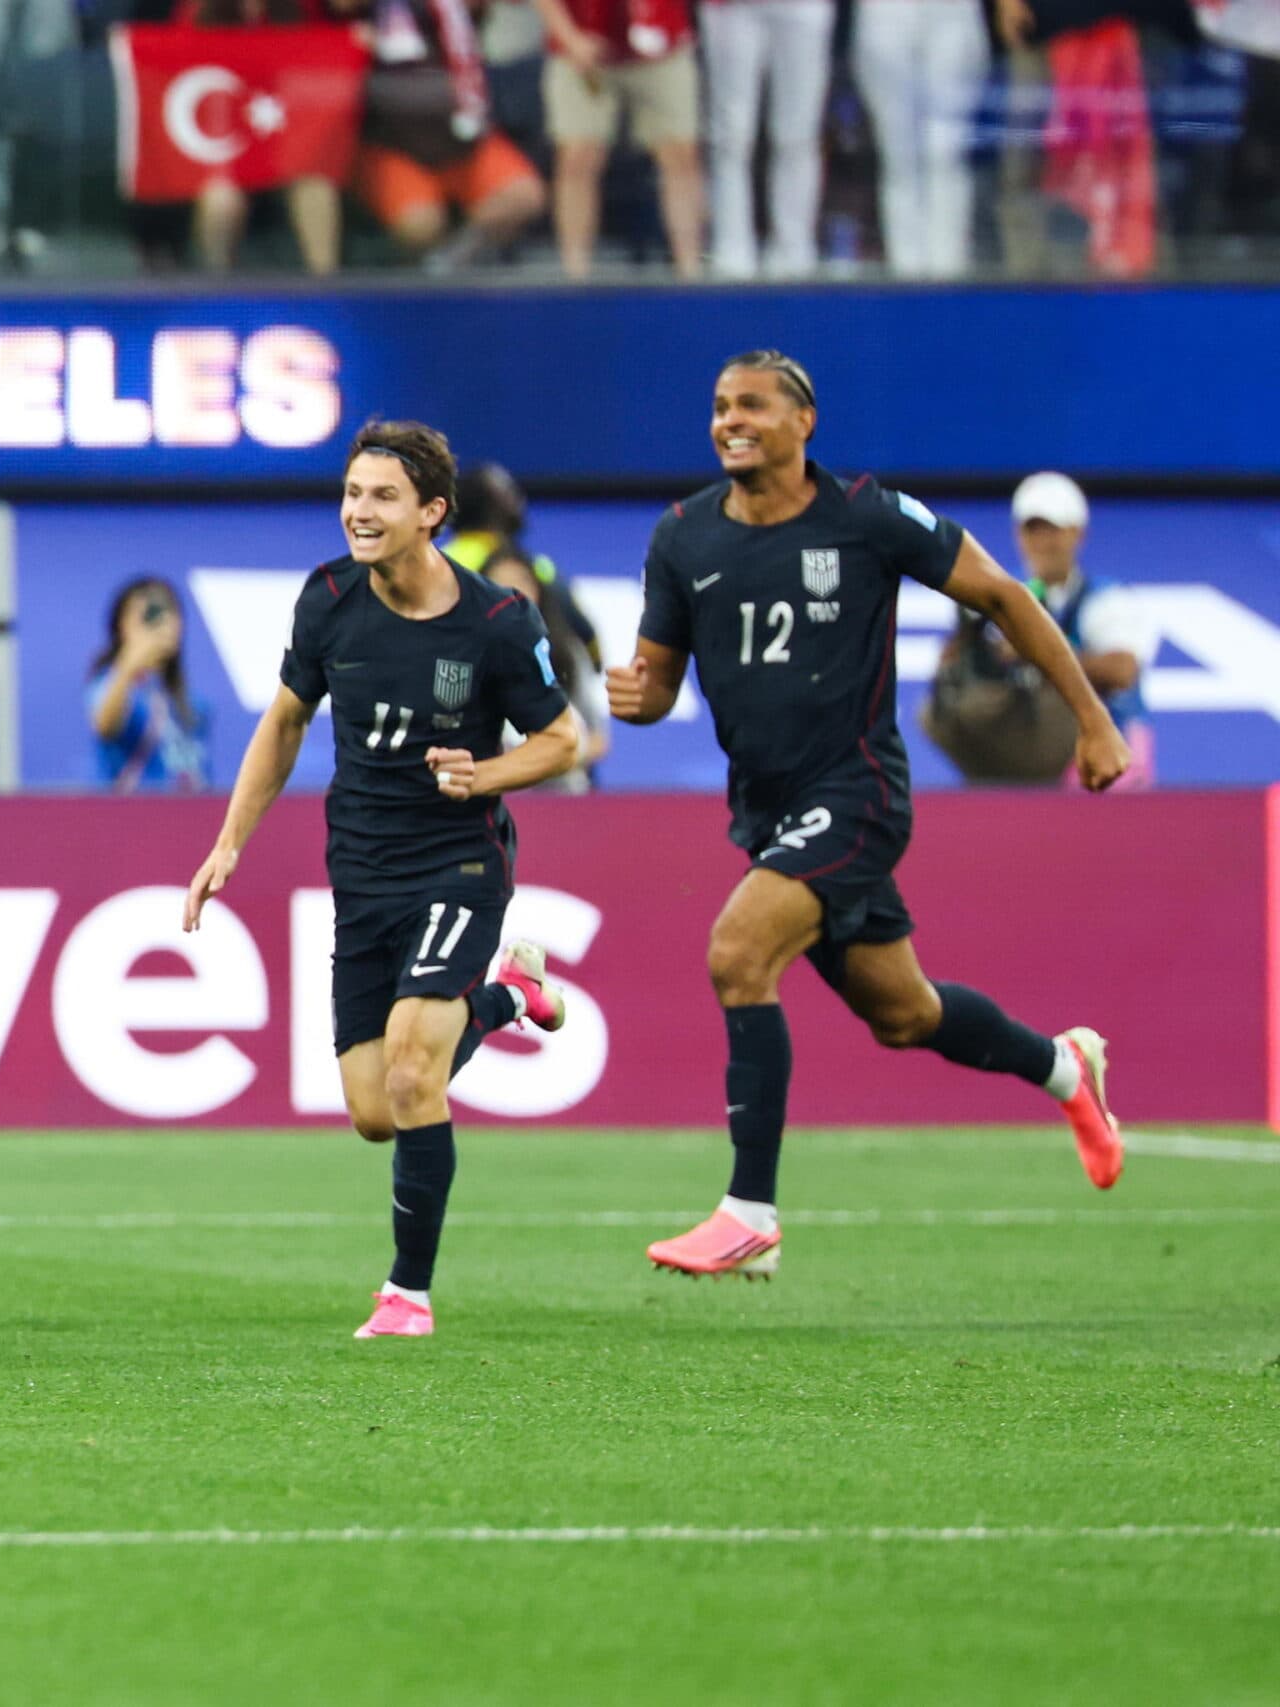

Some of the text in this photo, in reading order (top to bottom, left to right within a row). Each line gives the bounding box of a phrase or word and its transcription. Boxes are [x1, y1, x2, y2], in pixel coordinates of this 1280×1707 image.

[739, 601, 795, 666] 12
[439, 663, 469, 683] USA
[366, 702, 415, 750] 11
[417, 902, 473, 961] 11
